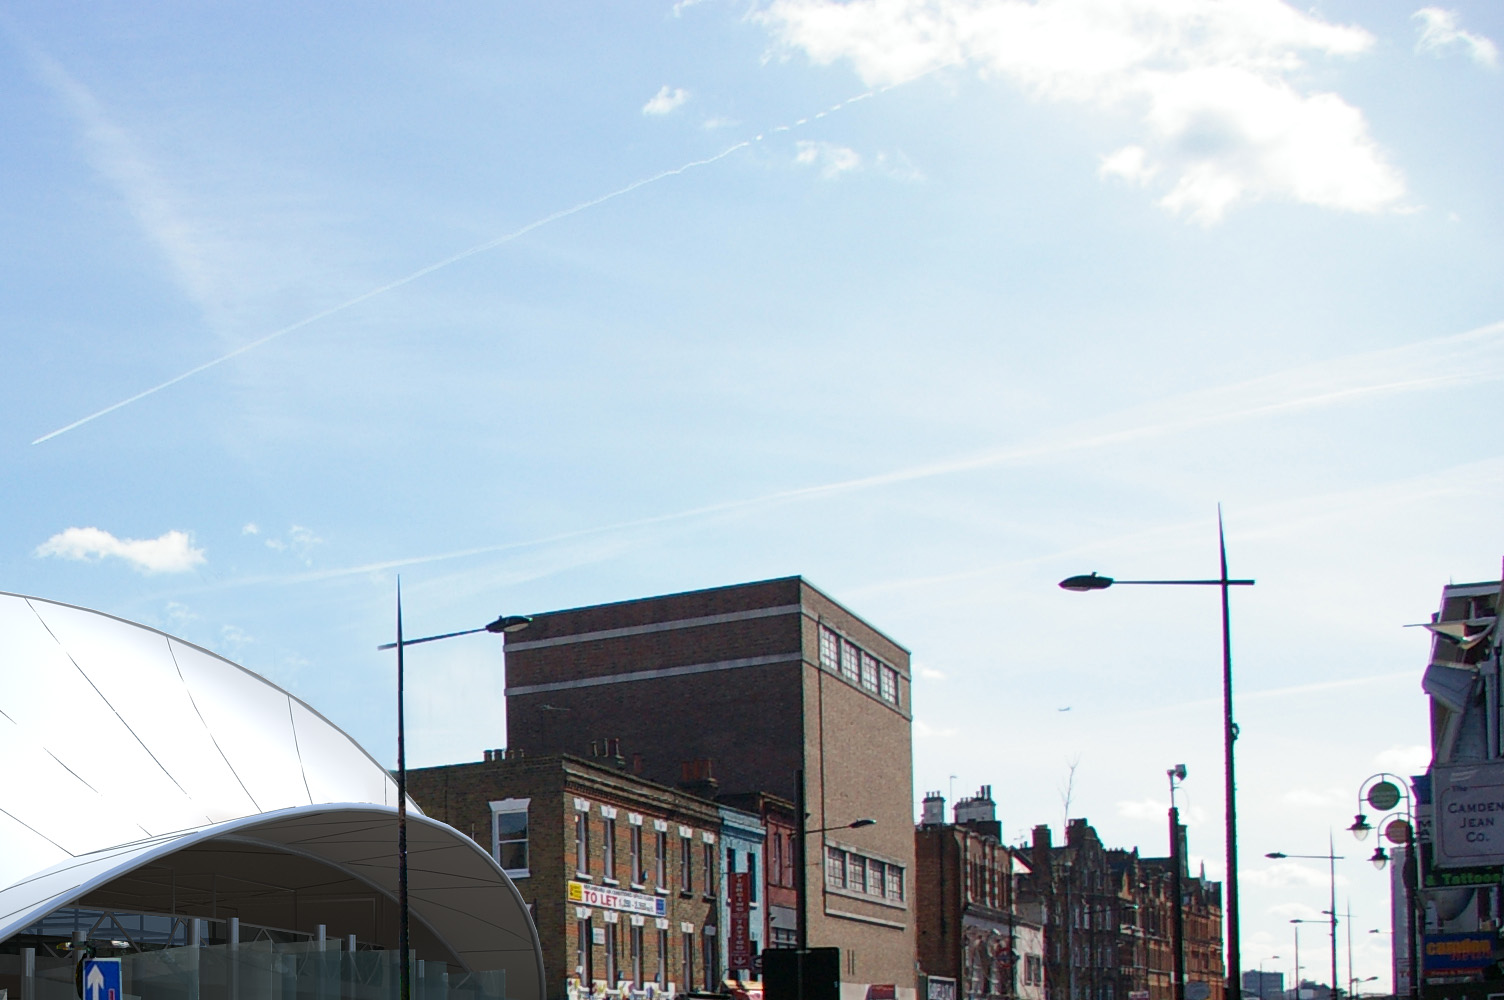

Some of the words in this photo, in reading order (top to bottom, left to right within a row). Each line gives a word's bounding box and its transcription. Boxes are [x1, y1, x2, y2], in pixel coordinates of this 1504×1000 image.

[1447, 801, 1504, 814] CAMDEN
[1459, 818, 1494, 829] JEAN
[583, 890, 598, 903] TO
[600, 895, 618, 907] LET
